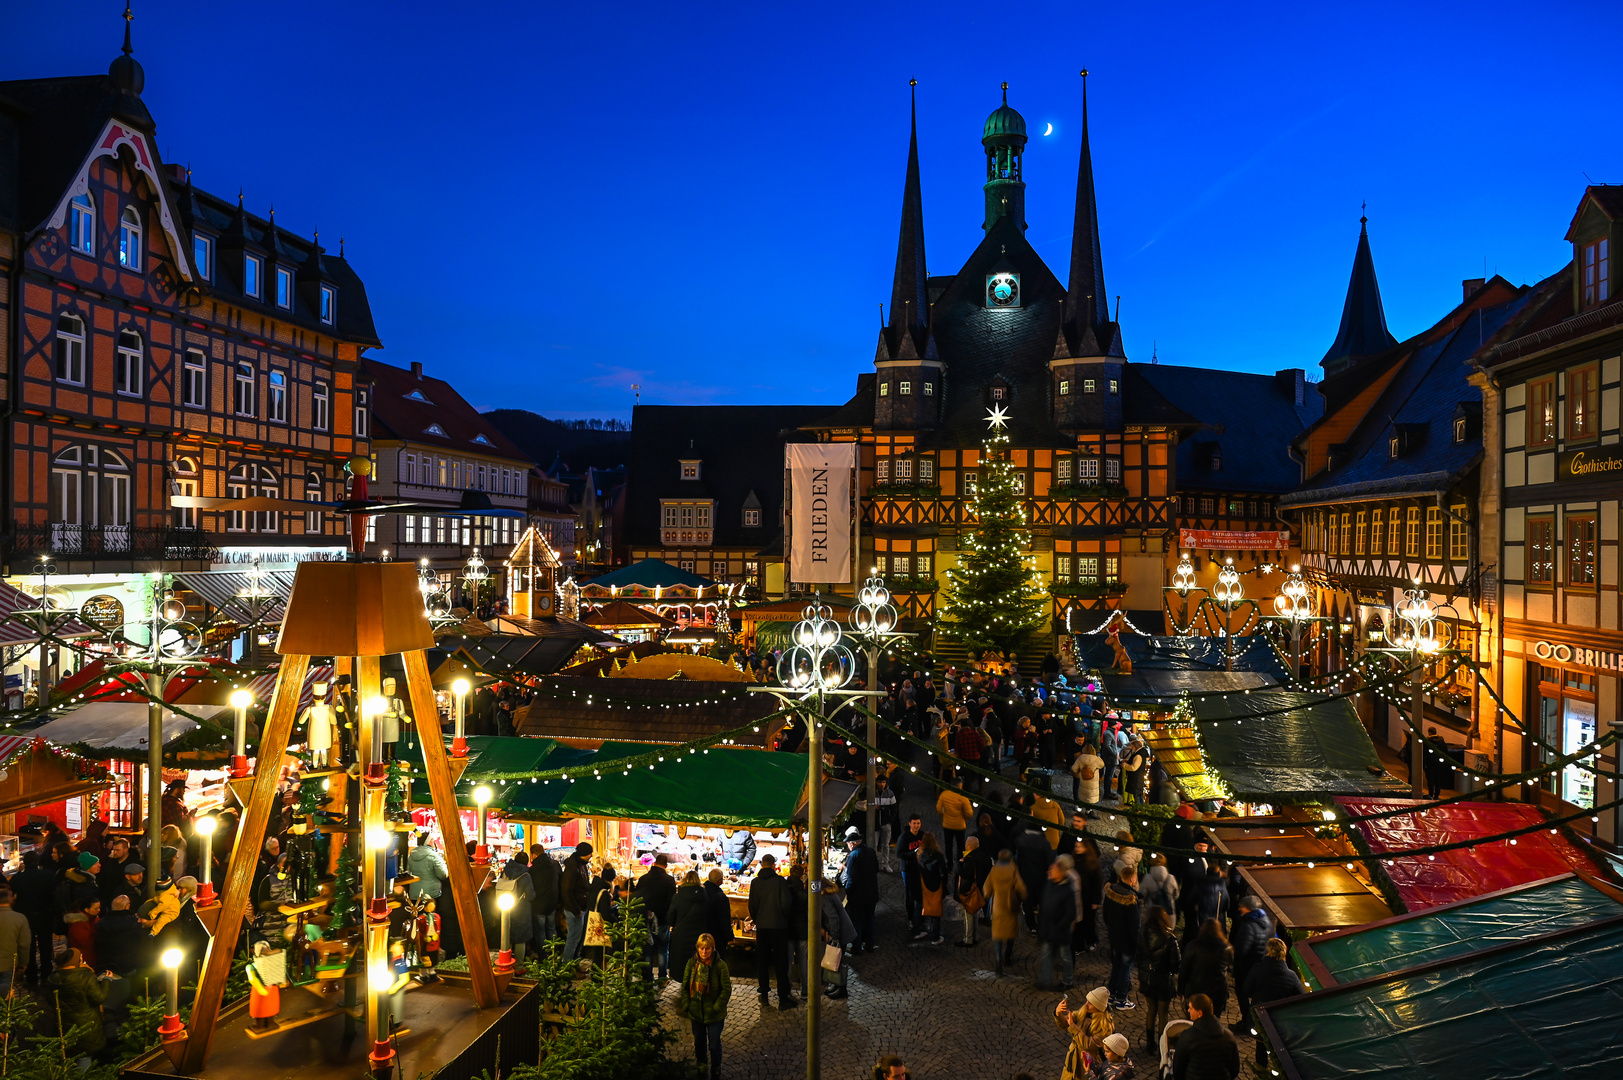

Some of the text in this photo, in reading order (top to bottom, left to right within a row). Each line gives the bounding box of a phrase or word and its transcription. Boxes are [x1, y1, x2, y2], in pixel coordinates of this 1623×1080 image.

[1570, 451, 1623, 476] Gothisches
[812, 462, 829, 563] FRIEDEN.
[266, 551, 290, 563] MARKT
